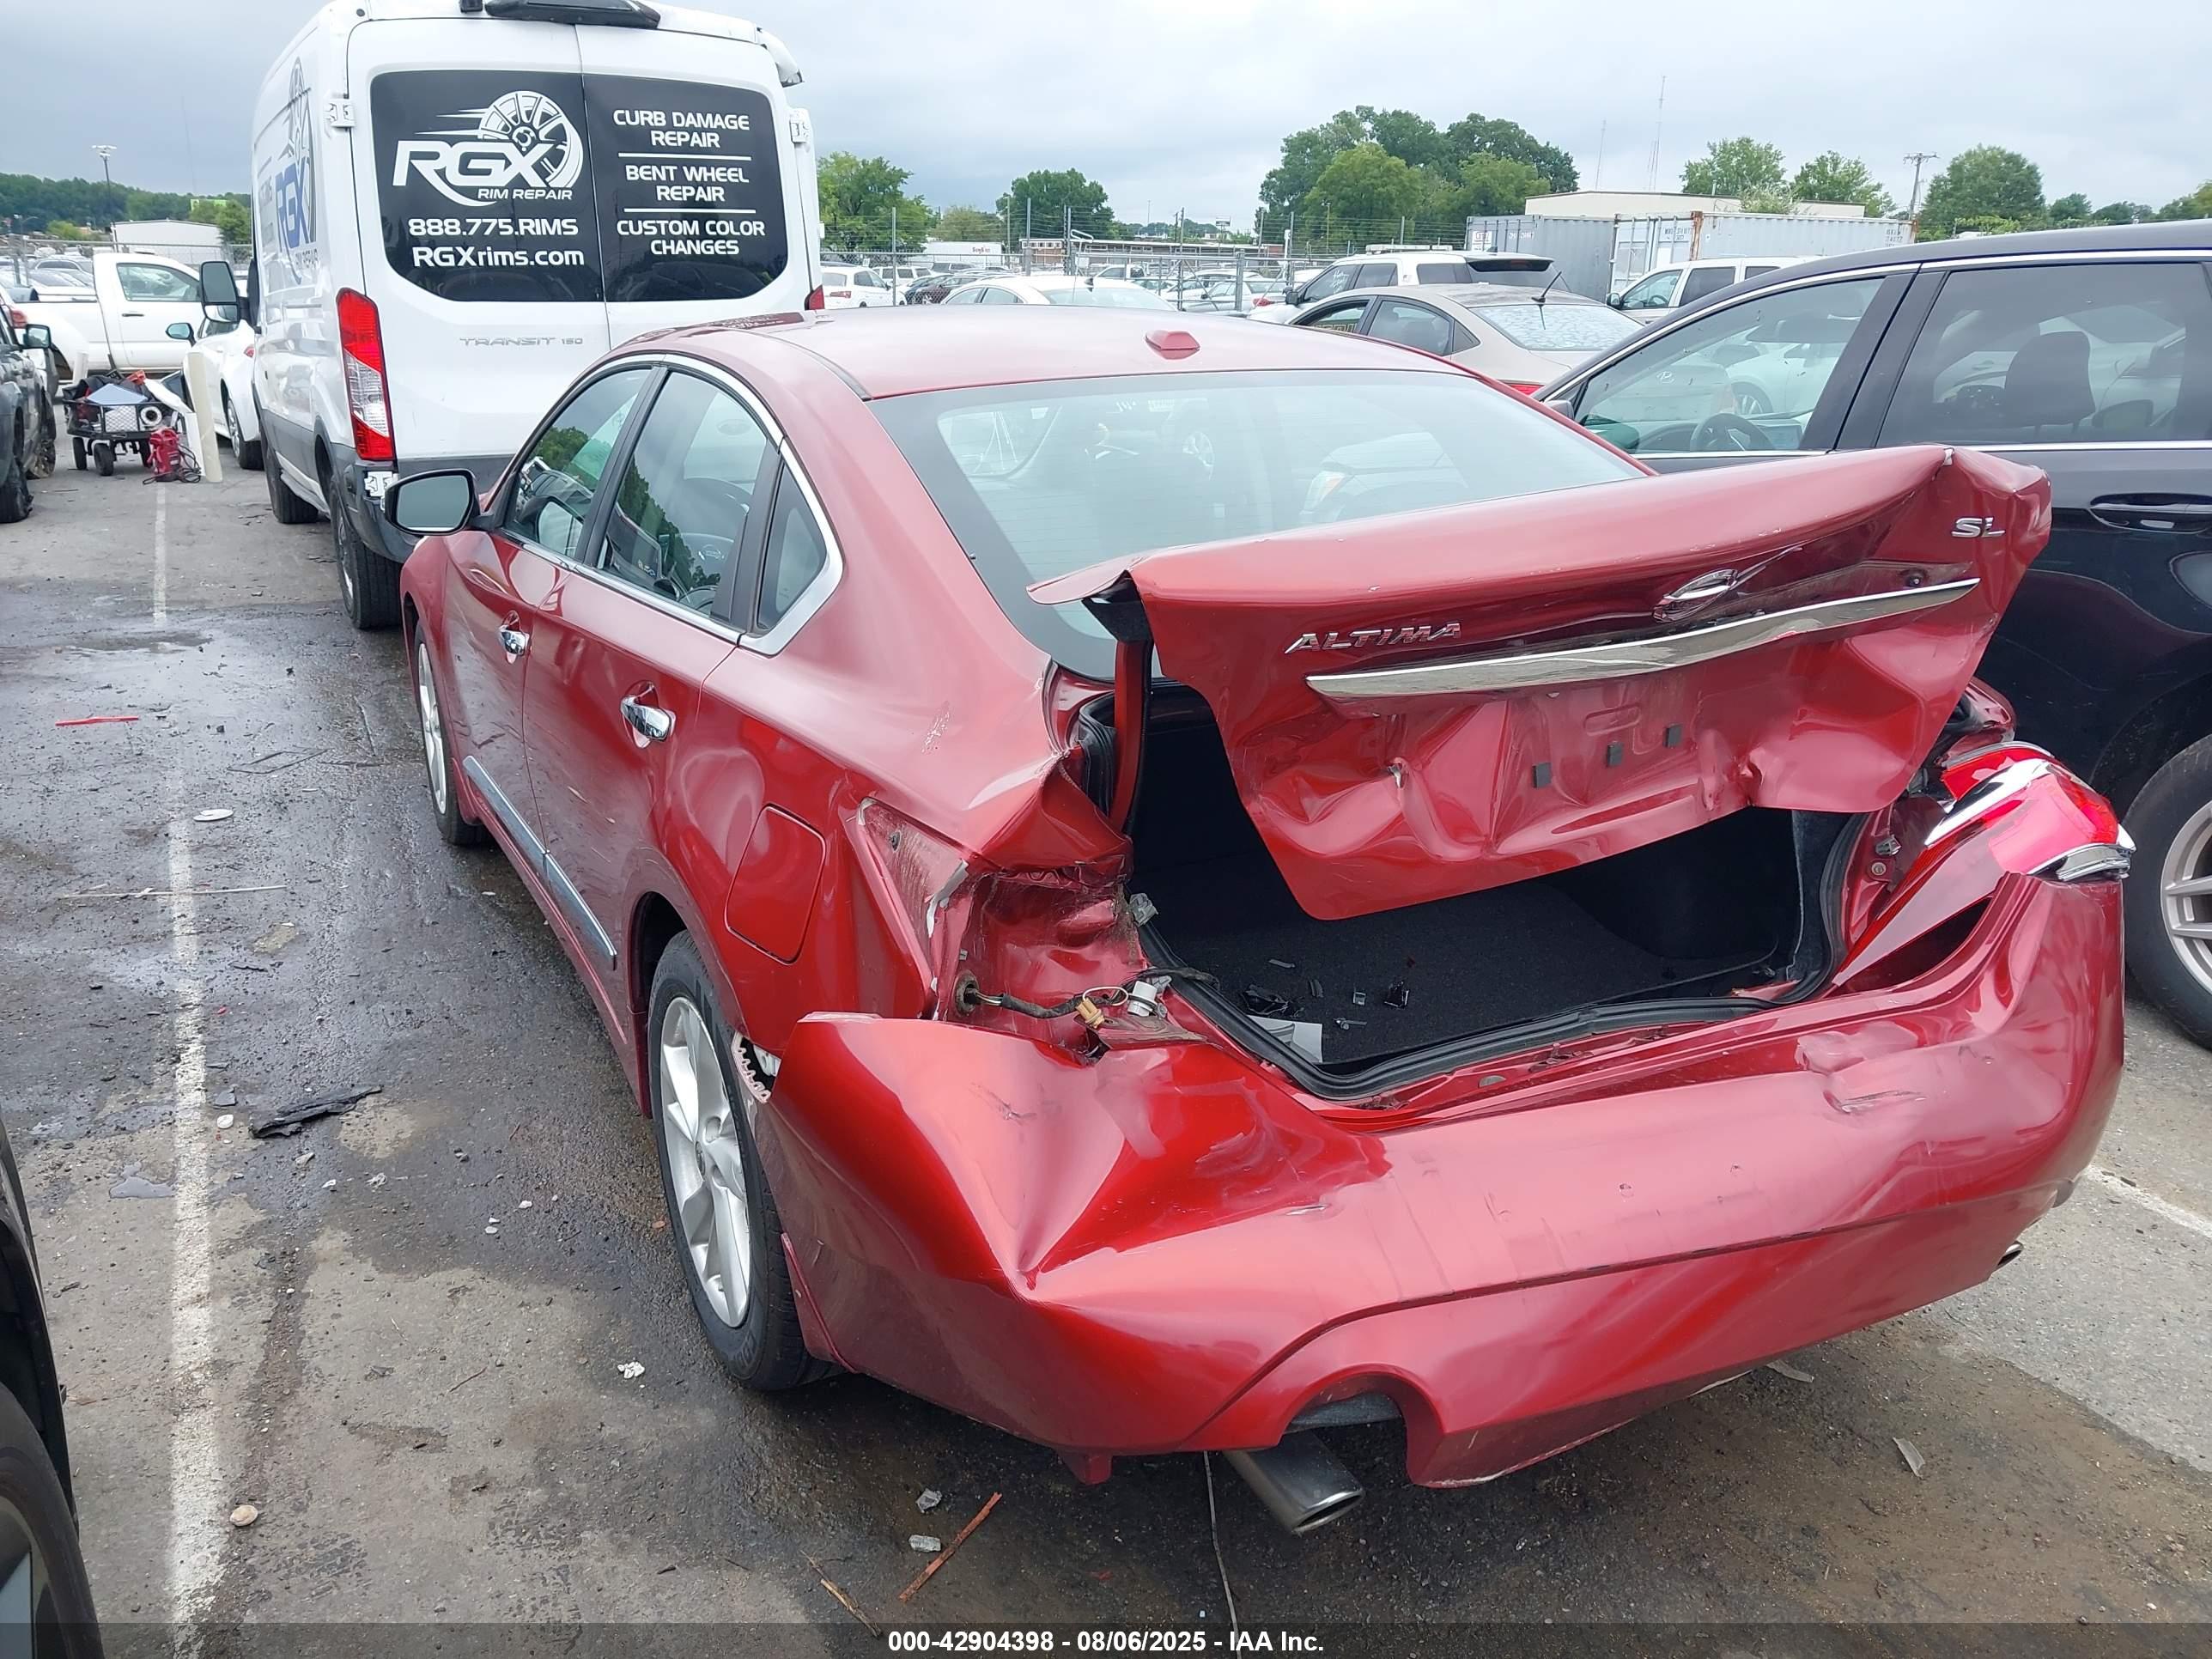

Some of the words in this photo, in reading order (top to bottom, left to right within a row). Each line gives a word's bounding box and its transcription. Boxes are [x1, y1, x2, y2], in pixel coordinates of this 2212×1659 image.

[613, 109, 666, 128] CURB
[672, 112, 750, 131] DAMAGE
[651, 131, 720, 149] REPAIR
[392, 139, 551, 206] RGX
[625, 165, 679, 183] BENT
[683, 166, 750, 184] WHEEL
[477, 188, 511, 200] RIM
[513, 188, 573, 201] REPAIR
[656, 185, 726, 203] REPAIR
[408, 218, 579, 236] 888.775.RIMS
[617, 220, 701, 237] CUSTOM
[705, 219, 765, 237] COLOR
[413, 246, 584, 267] RGXrims.com
[650, 239, 740, 256] CHANGES
[459, 337, 556, 347] TRANSIT
[1951, 515, 2005, 538] SL
[1284, 620, 1462, 655] ALTIMA
